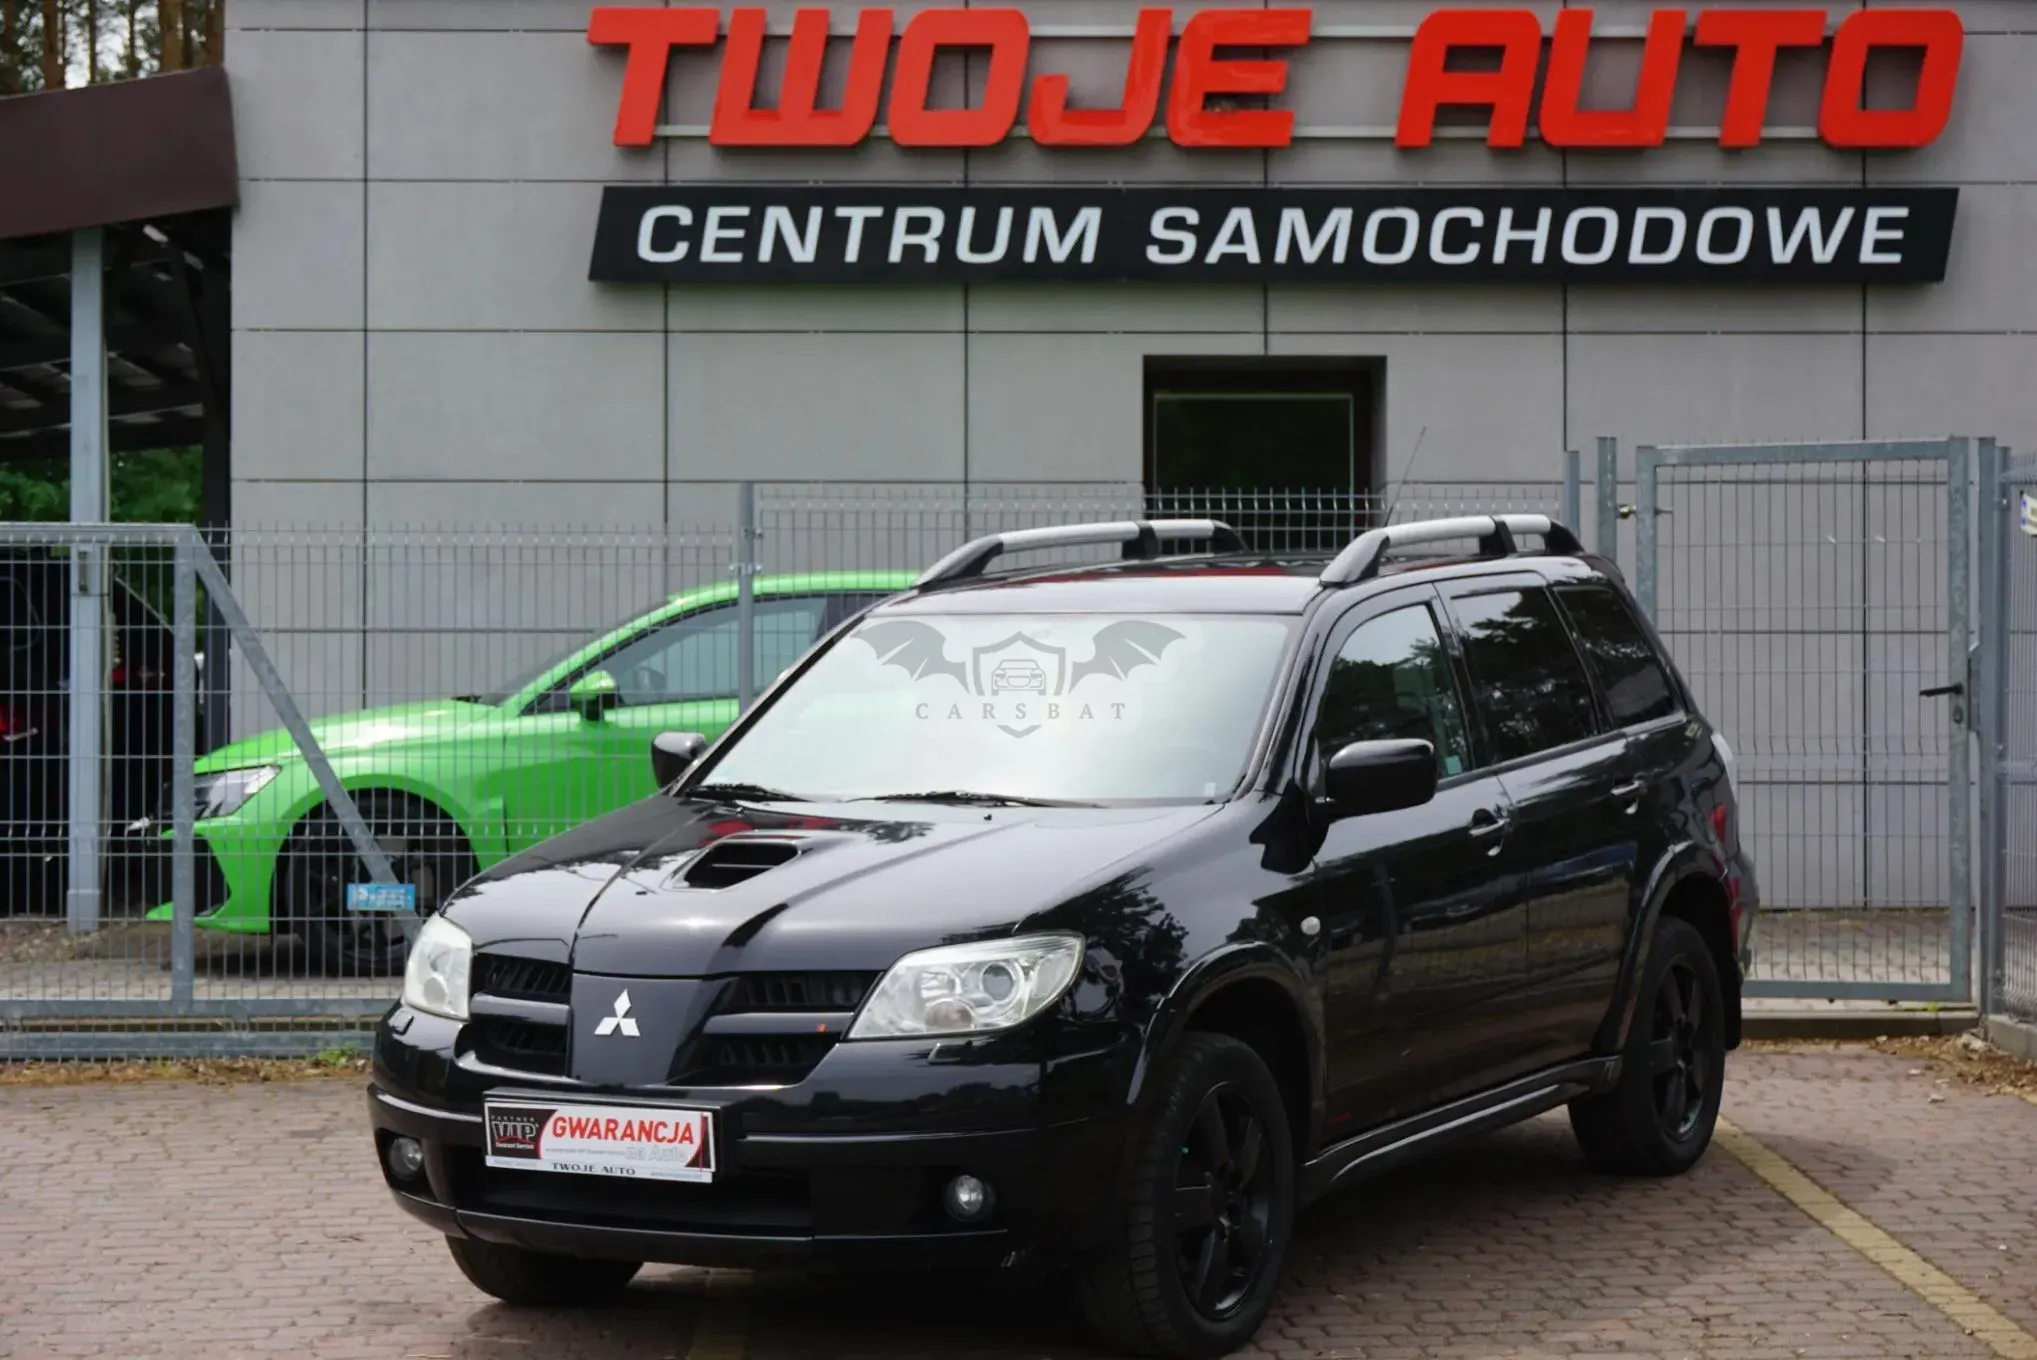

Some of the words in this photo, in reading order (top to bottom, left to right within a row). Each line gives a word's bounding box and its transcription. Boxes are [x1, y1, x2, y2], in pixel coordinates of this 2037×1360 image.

[588, 7, 1312, 147] TWOJE
[1395, 8, 1964, 149] AUTO
[636, 204, 1103, 264] CENTRUM
[1145, 206, 1910, 266] SAMOCHODOWE
[552, 1115, 695, 1145] GWARANCJA
[552, 1162, 595, 1173] TWOJE
[602, 1166, 636, 1176] AUTO
